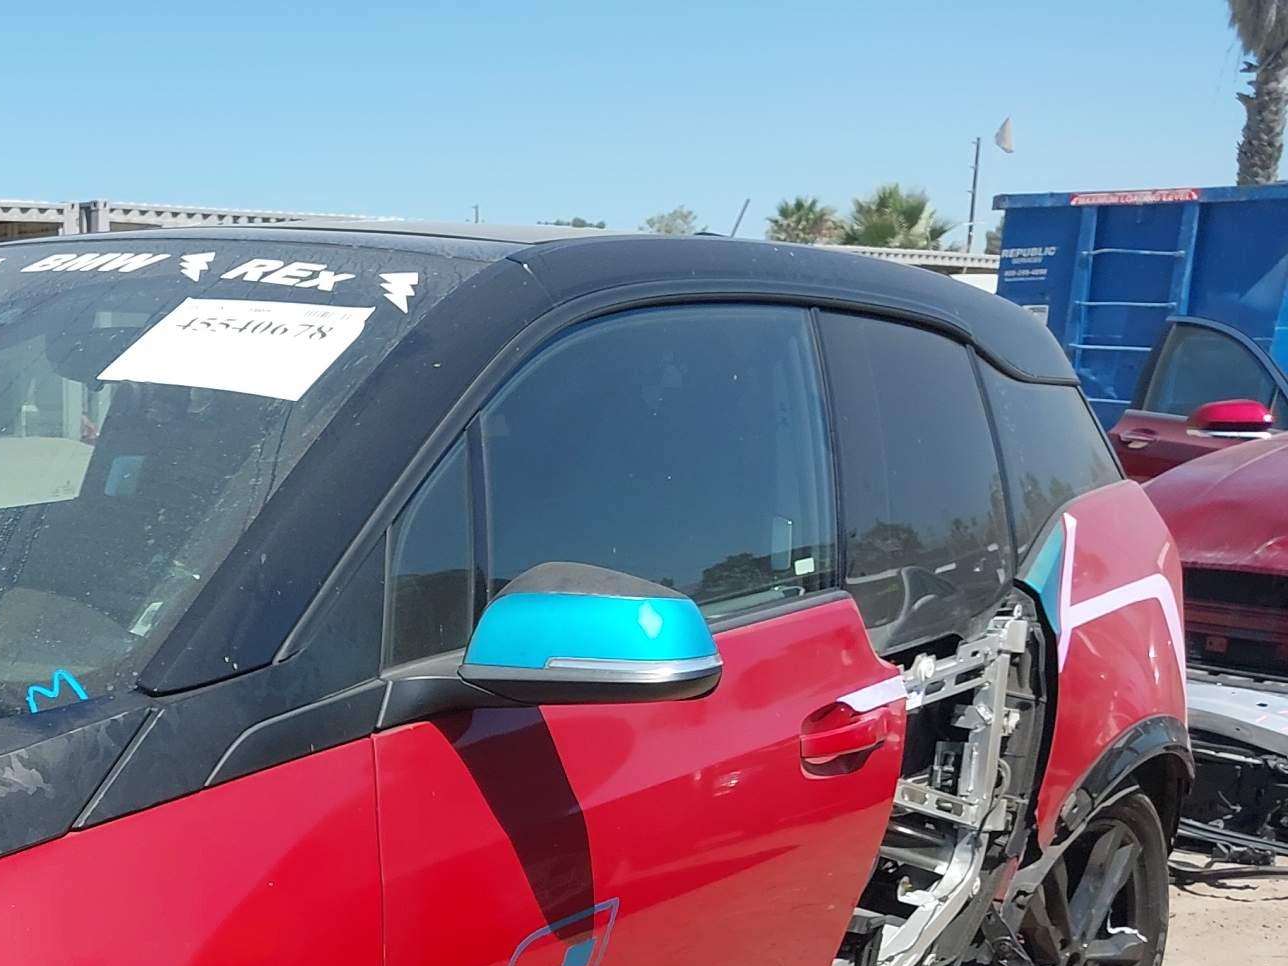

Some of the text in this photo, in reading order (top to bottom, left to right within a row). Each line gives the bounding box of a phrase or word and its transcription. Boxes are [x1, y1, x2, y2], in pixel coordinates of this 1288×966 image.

[1001, 246, 1057, 258] REPUBLIC
[20, 253, 172, 273] BMW
[176, 316, 334, 341] 45540678
